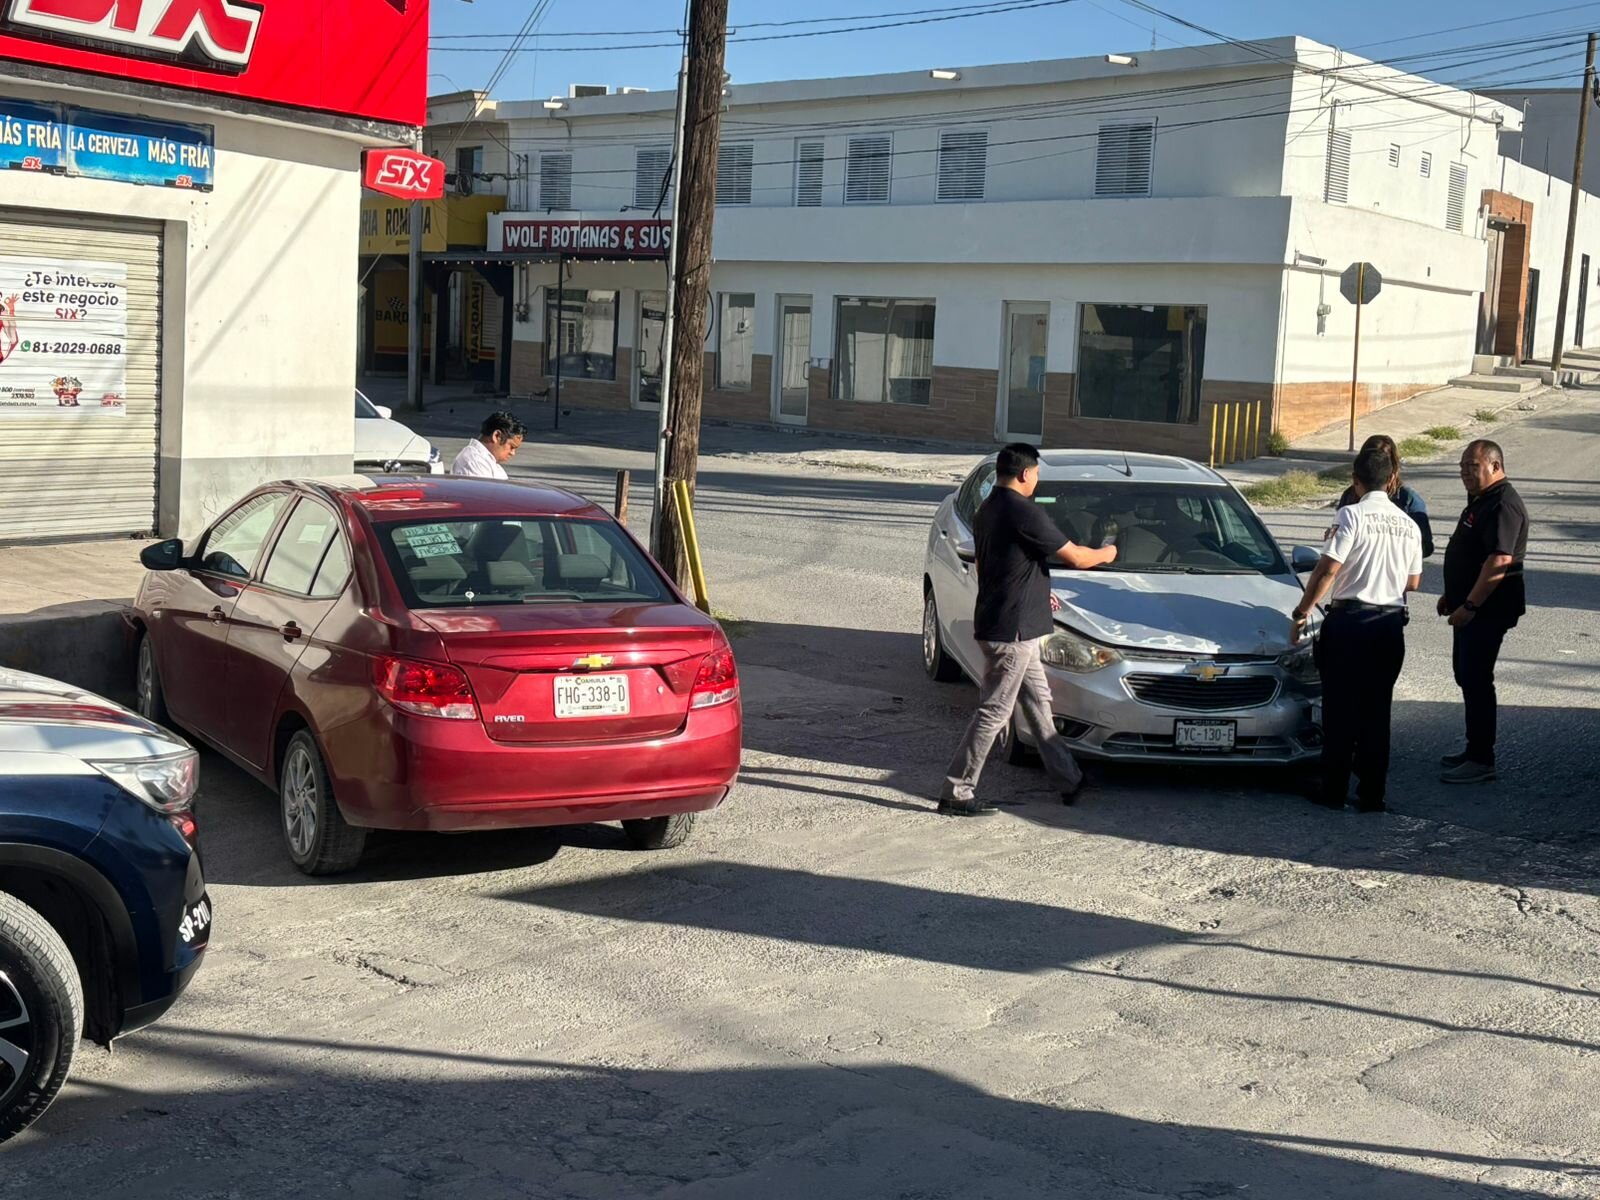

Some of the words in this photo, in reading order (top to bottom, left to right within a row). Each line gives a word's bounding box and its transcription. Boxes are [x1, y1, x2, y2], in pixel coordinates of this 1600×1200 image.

[0, 115, 22, 145] ÁS
[27, 121, 61, 149] FRÍA
[71, 131, 85, 151] LA
[88, 134, 139, 158] CERVEZA
[148, 136, 176, 165] MÁS
[180, 141, 210, 169] FRÍA
[386, 206, 431, 236] ROMA
[505, 226, 547, 248] WOLF
[551, 225, 620, 249] BOTANAS
[624, 226, 635, 250] &
[639, 226, 671, 249] SUS
[25, 271, 52, 287] ¿Te
[23, 290, 55, 303] este
[59, 291, 119, 308] negocio
[376, 310, 431, 325] BARDL
[1366, 523, 1414, 540] MUNICIPAL
[557, 684, 625, 705] FHG-338-D
